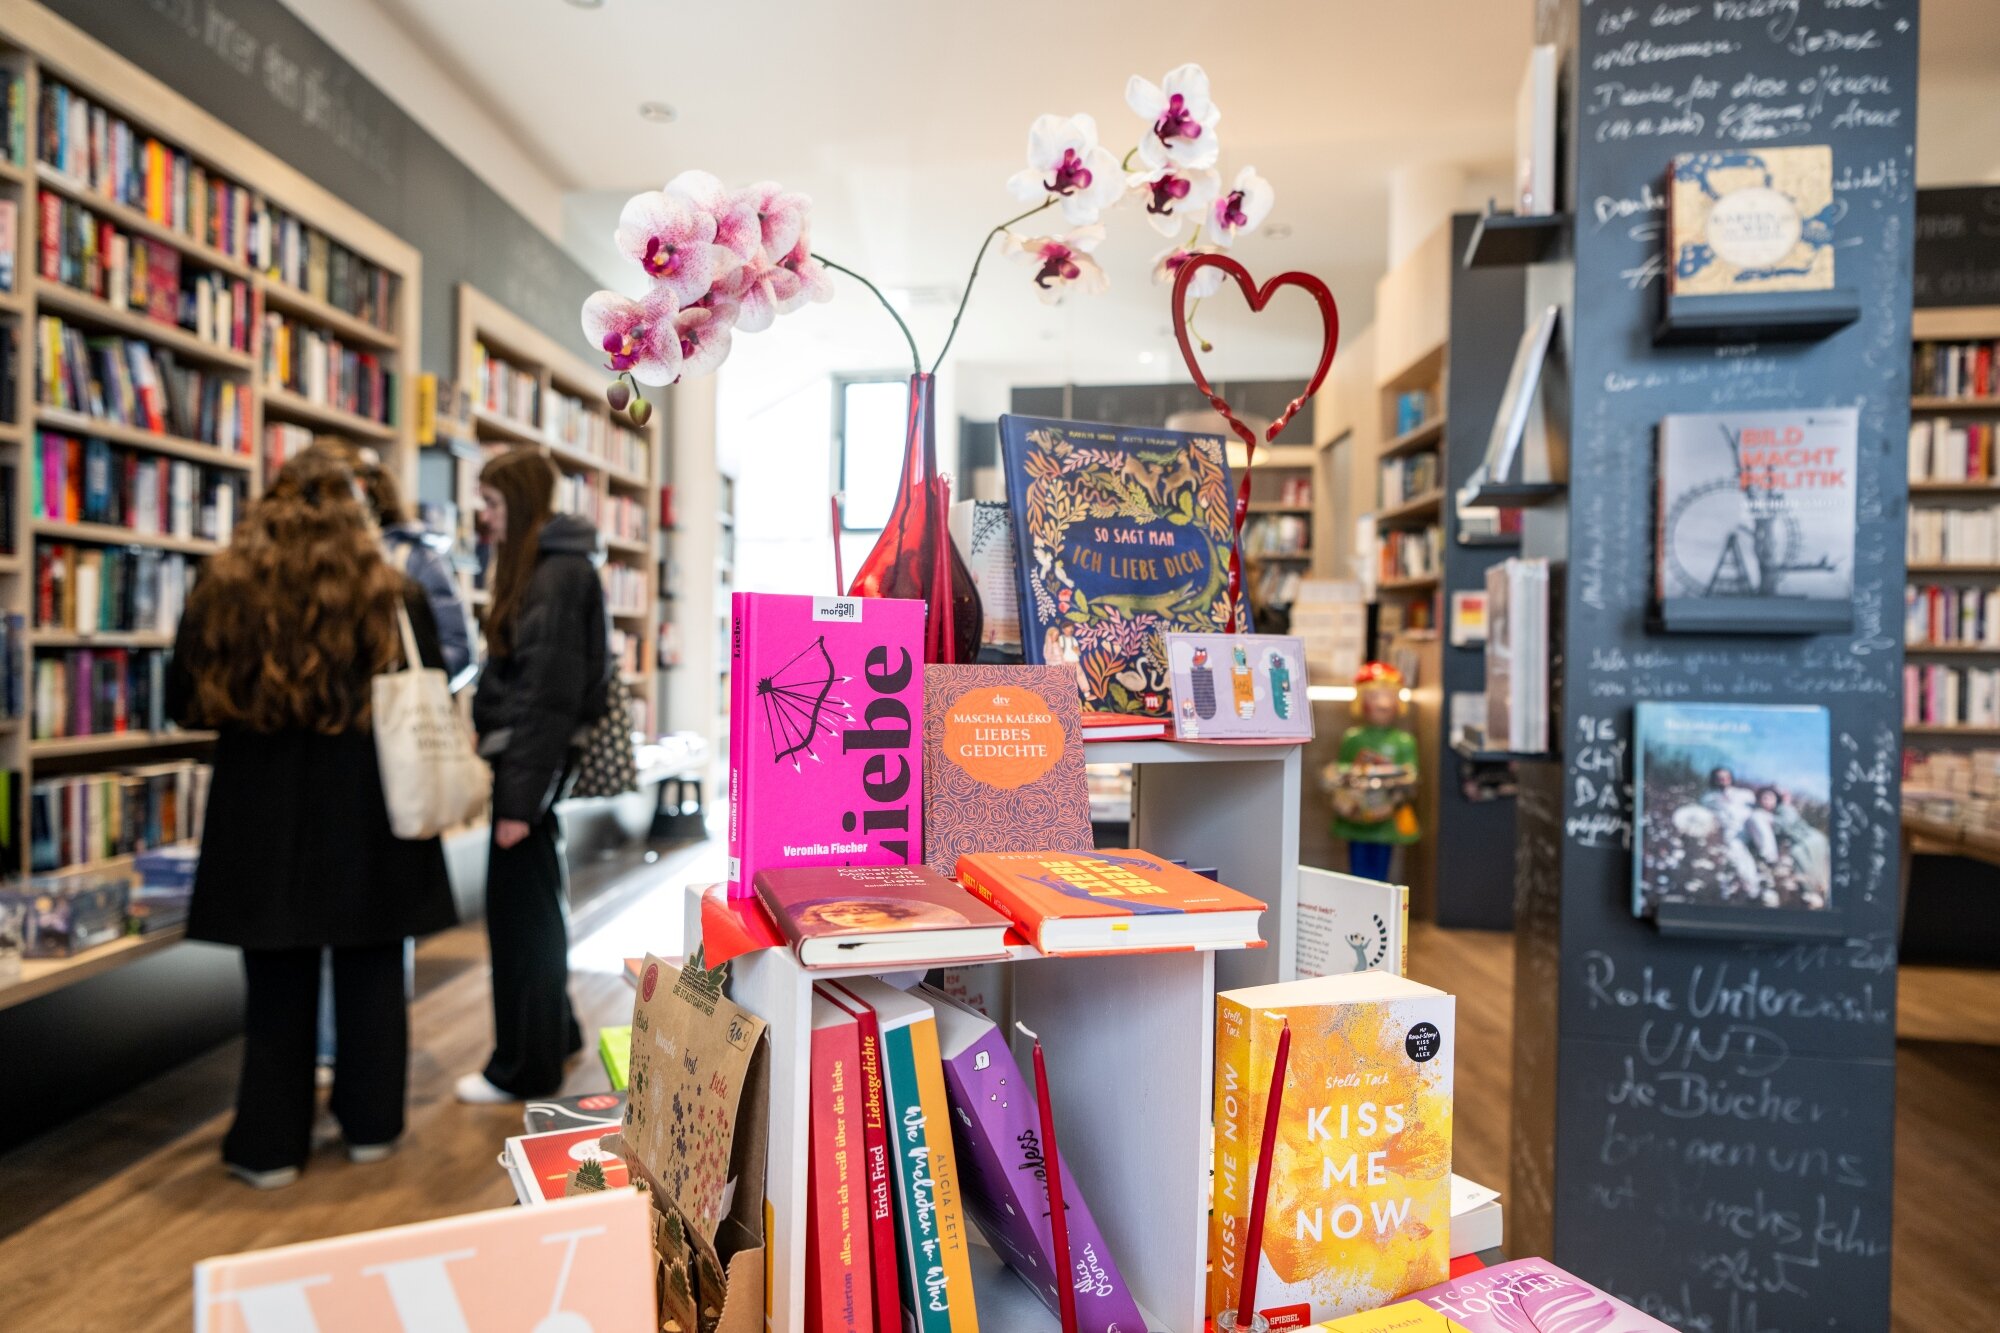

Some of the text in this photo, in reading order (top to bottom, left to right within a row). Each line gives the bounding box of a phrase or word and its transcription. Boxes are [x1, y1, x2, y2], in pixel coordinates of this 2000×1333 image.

[1741, 426, 1804, 448] BILD
[1741, 447, 1838, 468] MACHT
[1741, 470, 1845, 491] POLITIK
[1095, 528, 1174, 546] SO SAGT MAN
[1072, 545, 1204, 581] ICH LIEBE DICH
[732, 617, 741, 659] Liebe
[953, 712, 1052, 724] MASCHA KALÉKO
[992, 694, 1010, 706] dtv
[960, 744, 1048, 758] GEDICHTE
[974, 728, 1031, 742] LIEBES
[730, 802, 738, 842] Veronika
[783, 842, 868, 857] Veronika Fischer
[1223, 1007, 1243, 1026] Stella
[1225, 1022, 1240, 1039] Tack
[1640, 1020, 1791, 1077] UND
[861, 1035, 882, 1129] Liebesgedichte
[1325, 1071, 1389, 1089] Stella Tack
[1656, 1071, 1821, 1122] Bücher
[1306, 1101, 1406, 1141] KISS
[832, 1060, 853, 1266] alles, was ich weiß über die liebe
[1221, 1063, 1240, 1279] KISS ME NOW
[1321, 1150, 1388, 1190] ME
[870, 1145, 889, 1220] Erich Fried
[903, 1105, 950, 1312] Wie Melodien im Wind
[936, 1153, 959, 1251] ALICIA ZETT
[1295, 1197, 1412, 1242] NOW
[1074, 1260, 1096, 1293] Alice
[1083, 1243, 1113, 1297] Oseman
[1446, 1264, 1545, 1300] COLLEEN
[1428, 1274, 1574, 1320] HOOVER
[1270, 1313, 1299, 1325] SPIEGEL
